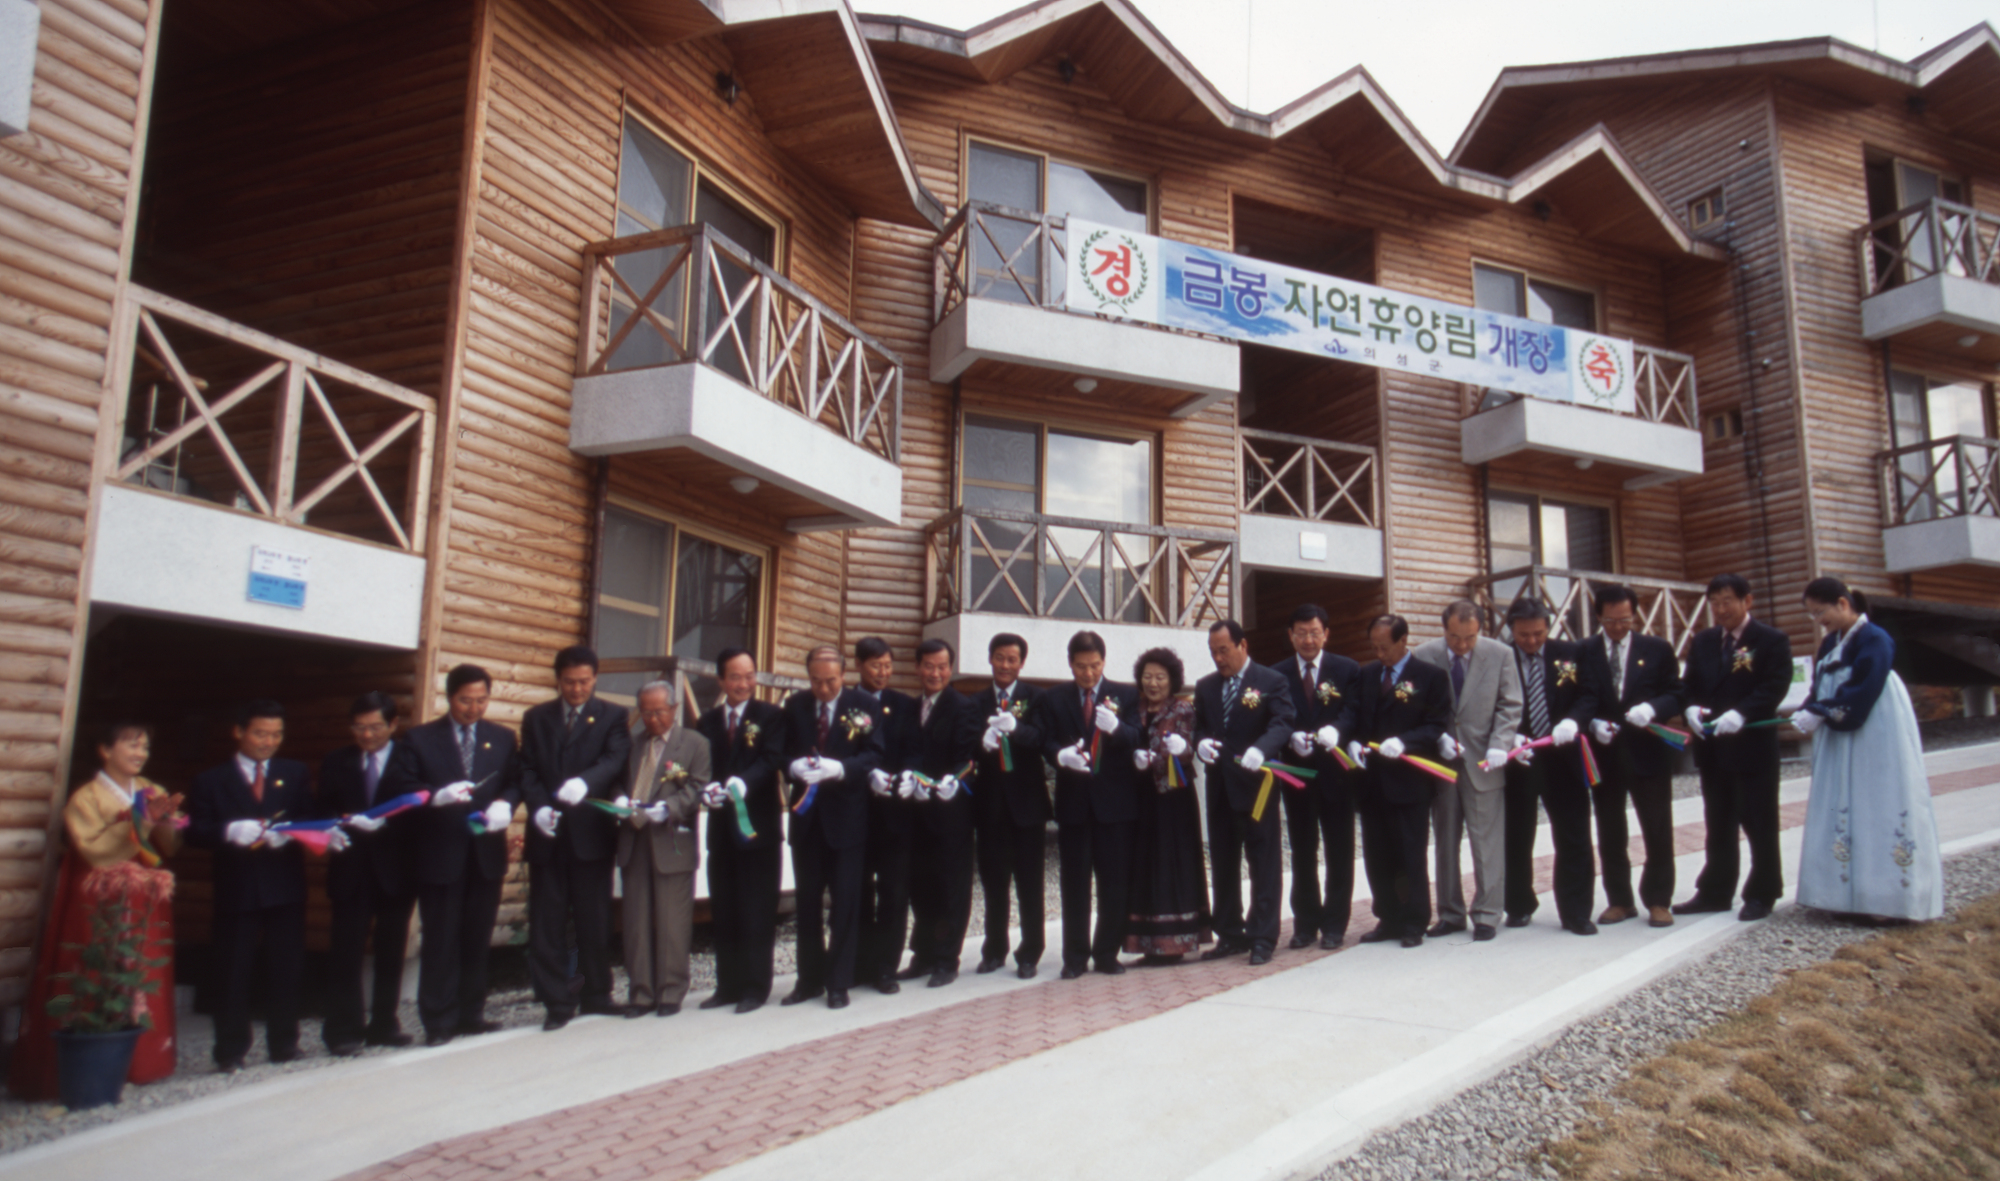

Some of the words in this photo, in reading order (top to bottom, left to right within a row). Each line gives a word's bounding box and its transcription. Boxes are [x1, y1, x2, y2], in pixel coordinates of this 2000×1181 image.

[1090, 244, 1131, 297] 경
[1183, 256, 1268, 318] 금봉
[1284, 278, 1476, 359] 자연휴양림
[1488, 323, 1552, 374] 개장
[1585, 345, 1617, 390] 축
